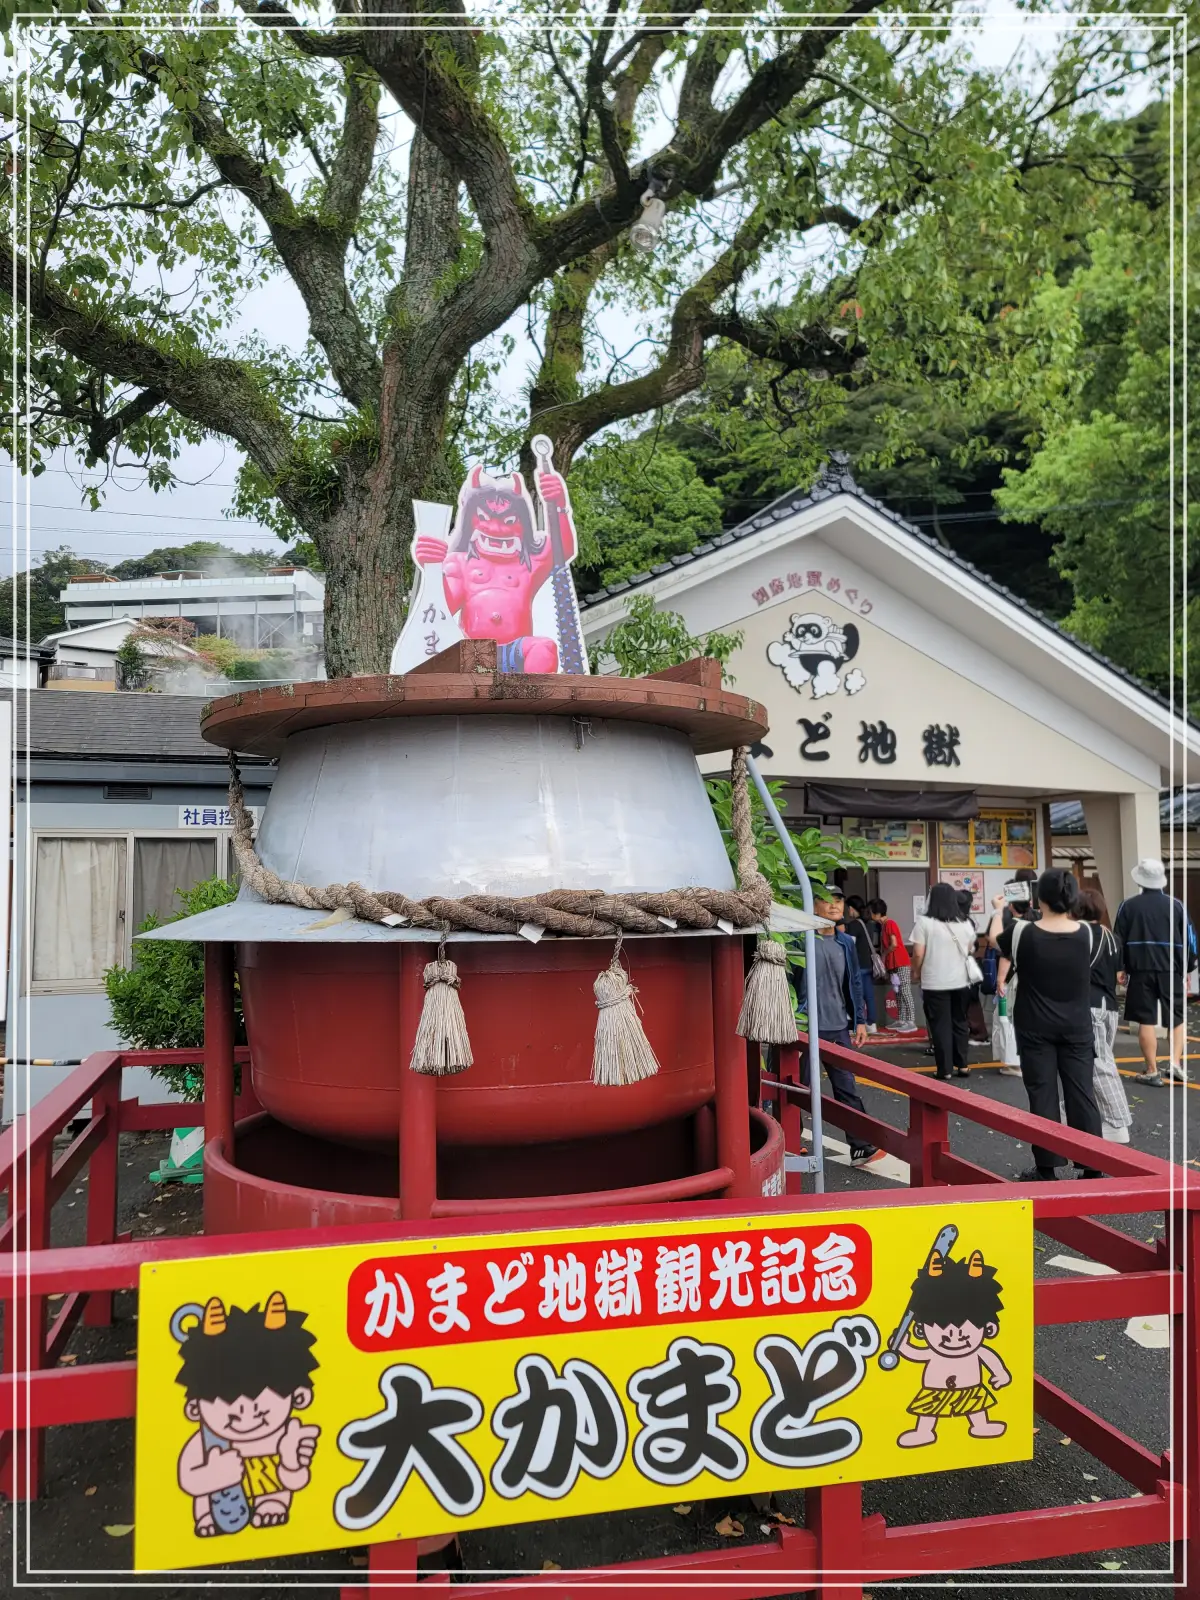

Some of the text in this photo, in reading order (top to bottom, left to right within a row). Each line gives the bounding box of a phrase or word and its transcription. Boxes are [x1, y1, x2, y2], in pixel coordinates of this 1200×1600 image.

[183, 808, 236, 826] 社員控
[363, 1231, 858, 1340] かまど地獄観光記念
[333, 1315, 880, 1531] 大かまど
